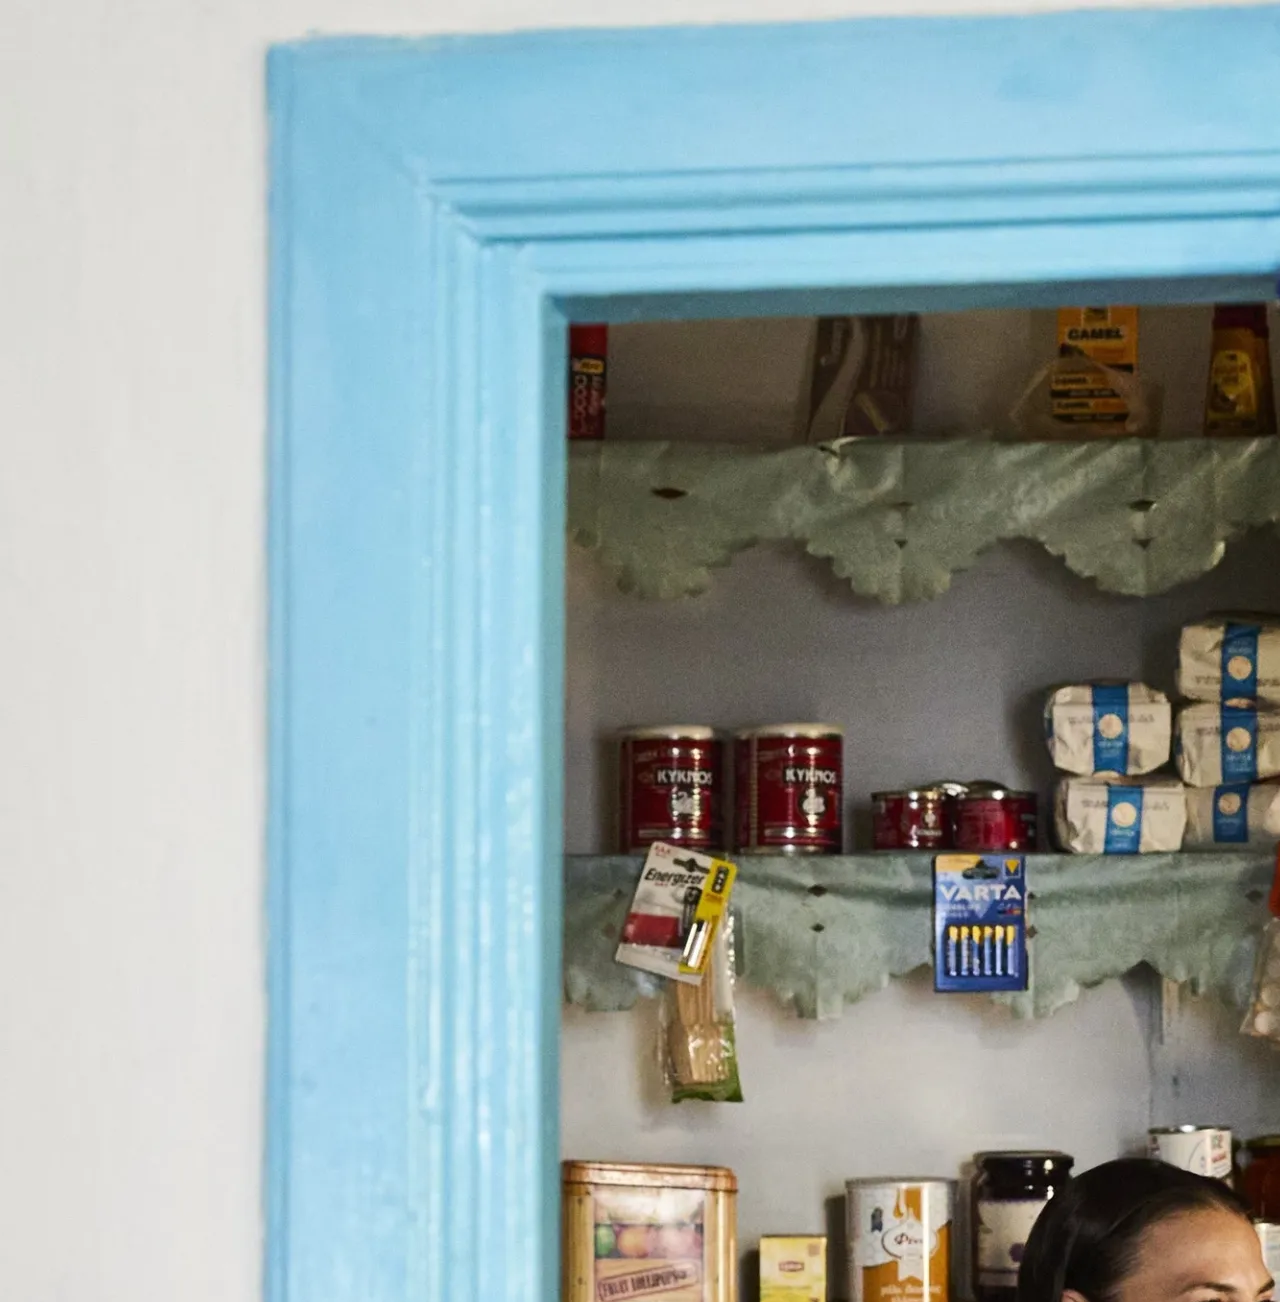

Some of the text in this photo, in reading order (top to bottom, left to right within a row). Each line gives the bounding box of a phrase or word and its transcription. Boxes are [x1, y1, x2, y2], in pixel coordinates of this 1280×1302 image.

[1067, 328, 1124, 340] CAMEL
[644, 868, 705, 887] Energizer
[939, 884, 1022, 901] VARTA
[602, 1279, 629, 1298] FRUIT
